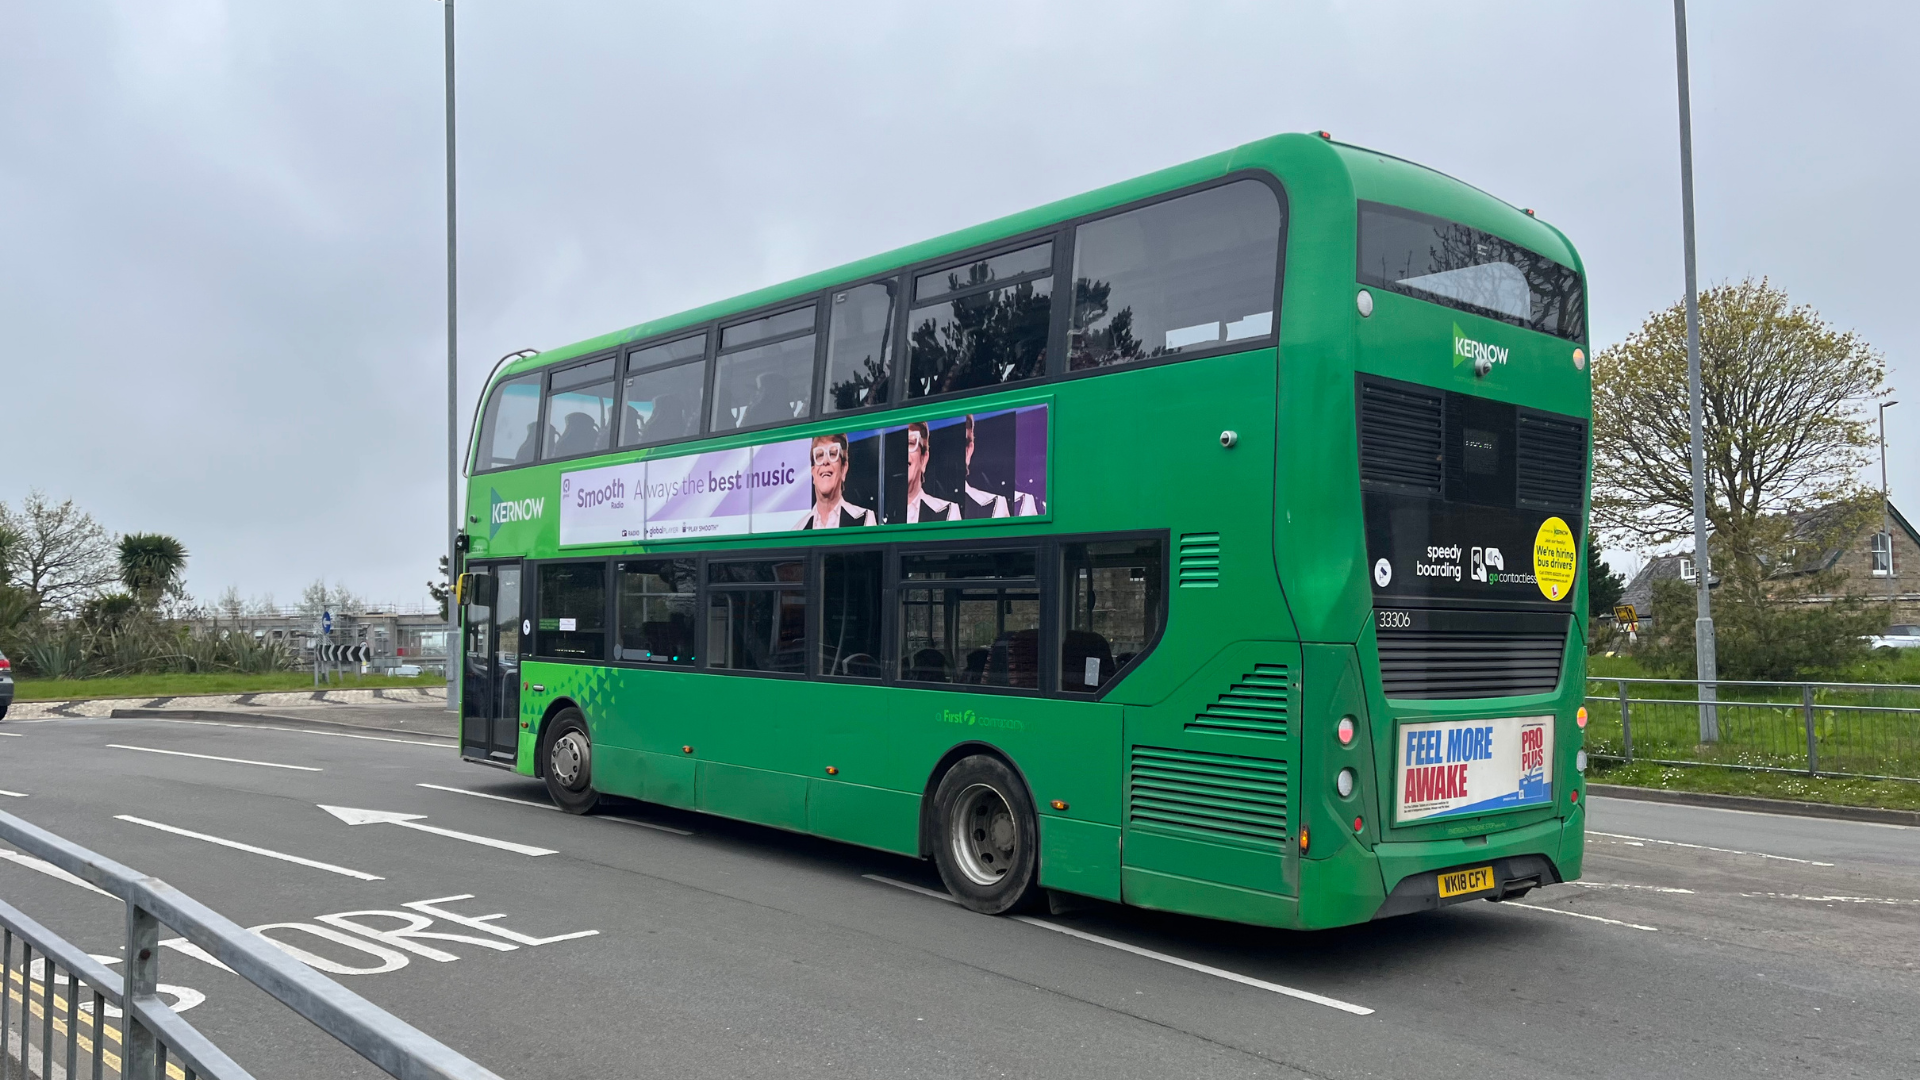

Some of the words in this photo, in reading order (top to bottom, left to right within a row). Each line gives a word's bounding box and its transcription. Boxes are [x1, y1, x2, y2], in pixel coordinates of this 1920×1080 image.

[1455, 336, 1509, 365] KERNOW
[577, 478, 625, 508] Smooth
[634, 479, 679, 503] Always
[682, 473, 705, 495] the
[708, 470, 742, 493] best
[746, 461, 795, 489] music
[492, 496, 545, 524] KERNOW
[611, 501, 624, 509] Radio
[1427, 543, 1462, 563] speedy
[1536, 545, 1555, 557] We're
[1556, 547, 1574, 562] hiring
[1537, 556, 1549, 568] bus
[1550, 558, 1573, 571] drivers
[1416, 560, 1462, 582] boarding
[1379, 611, 1411, 628] 33306
[943, 709, 963, 724] First
[1405, 730, 1443, 766] FEEL
[1446, 726, 1493, 763] MORE
[1522, 727, 1543, 753] PRO
[1522, 748, 1544, 771] PLUS
[1404, 764, 1468, 804] AWAKE
[1444, 873, 1467, 893] WK18
[1468, 869, 1487, 889] CFY
